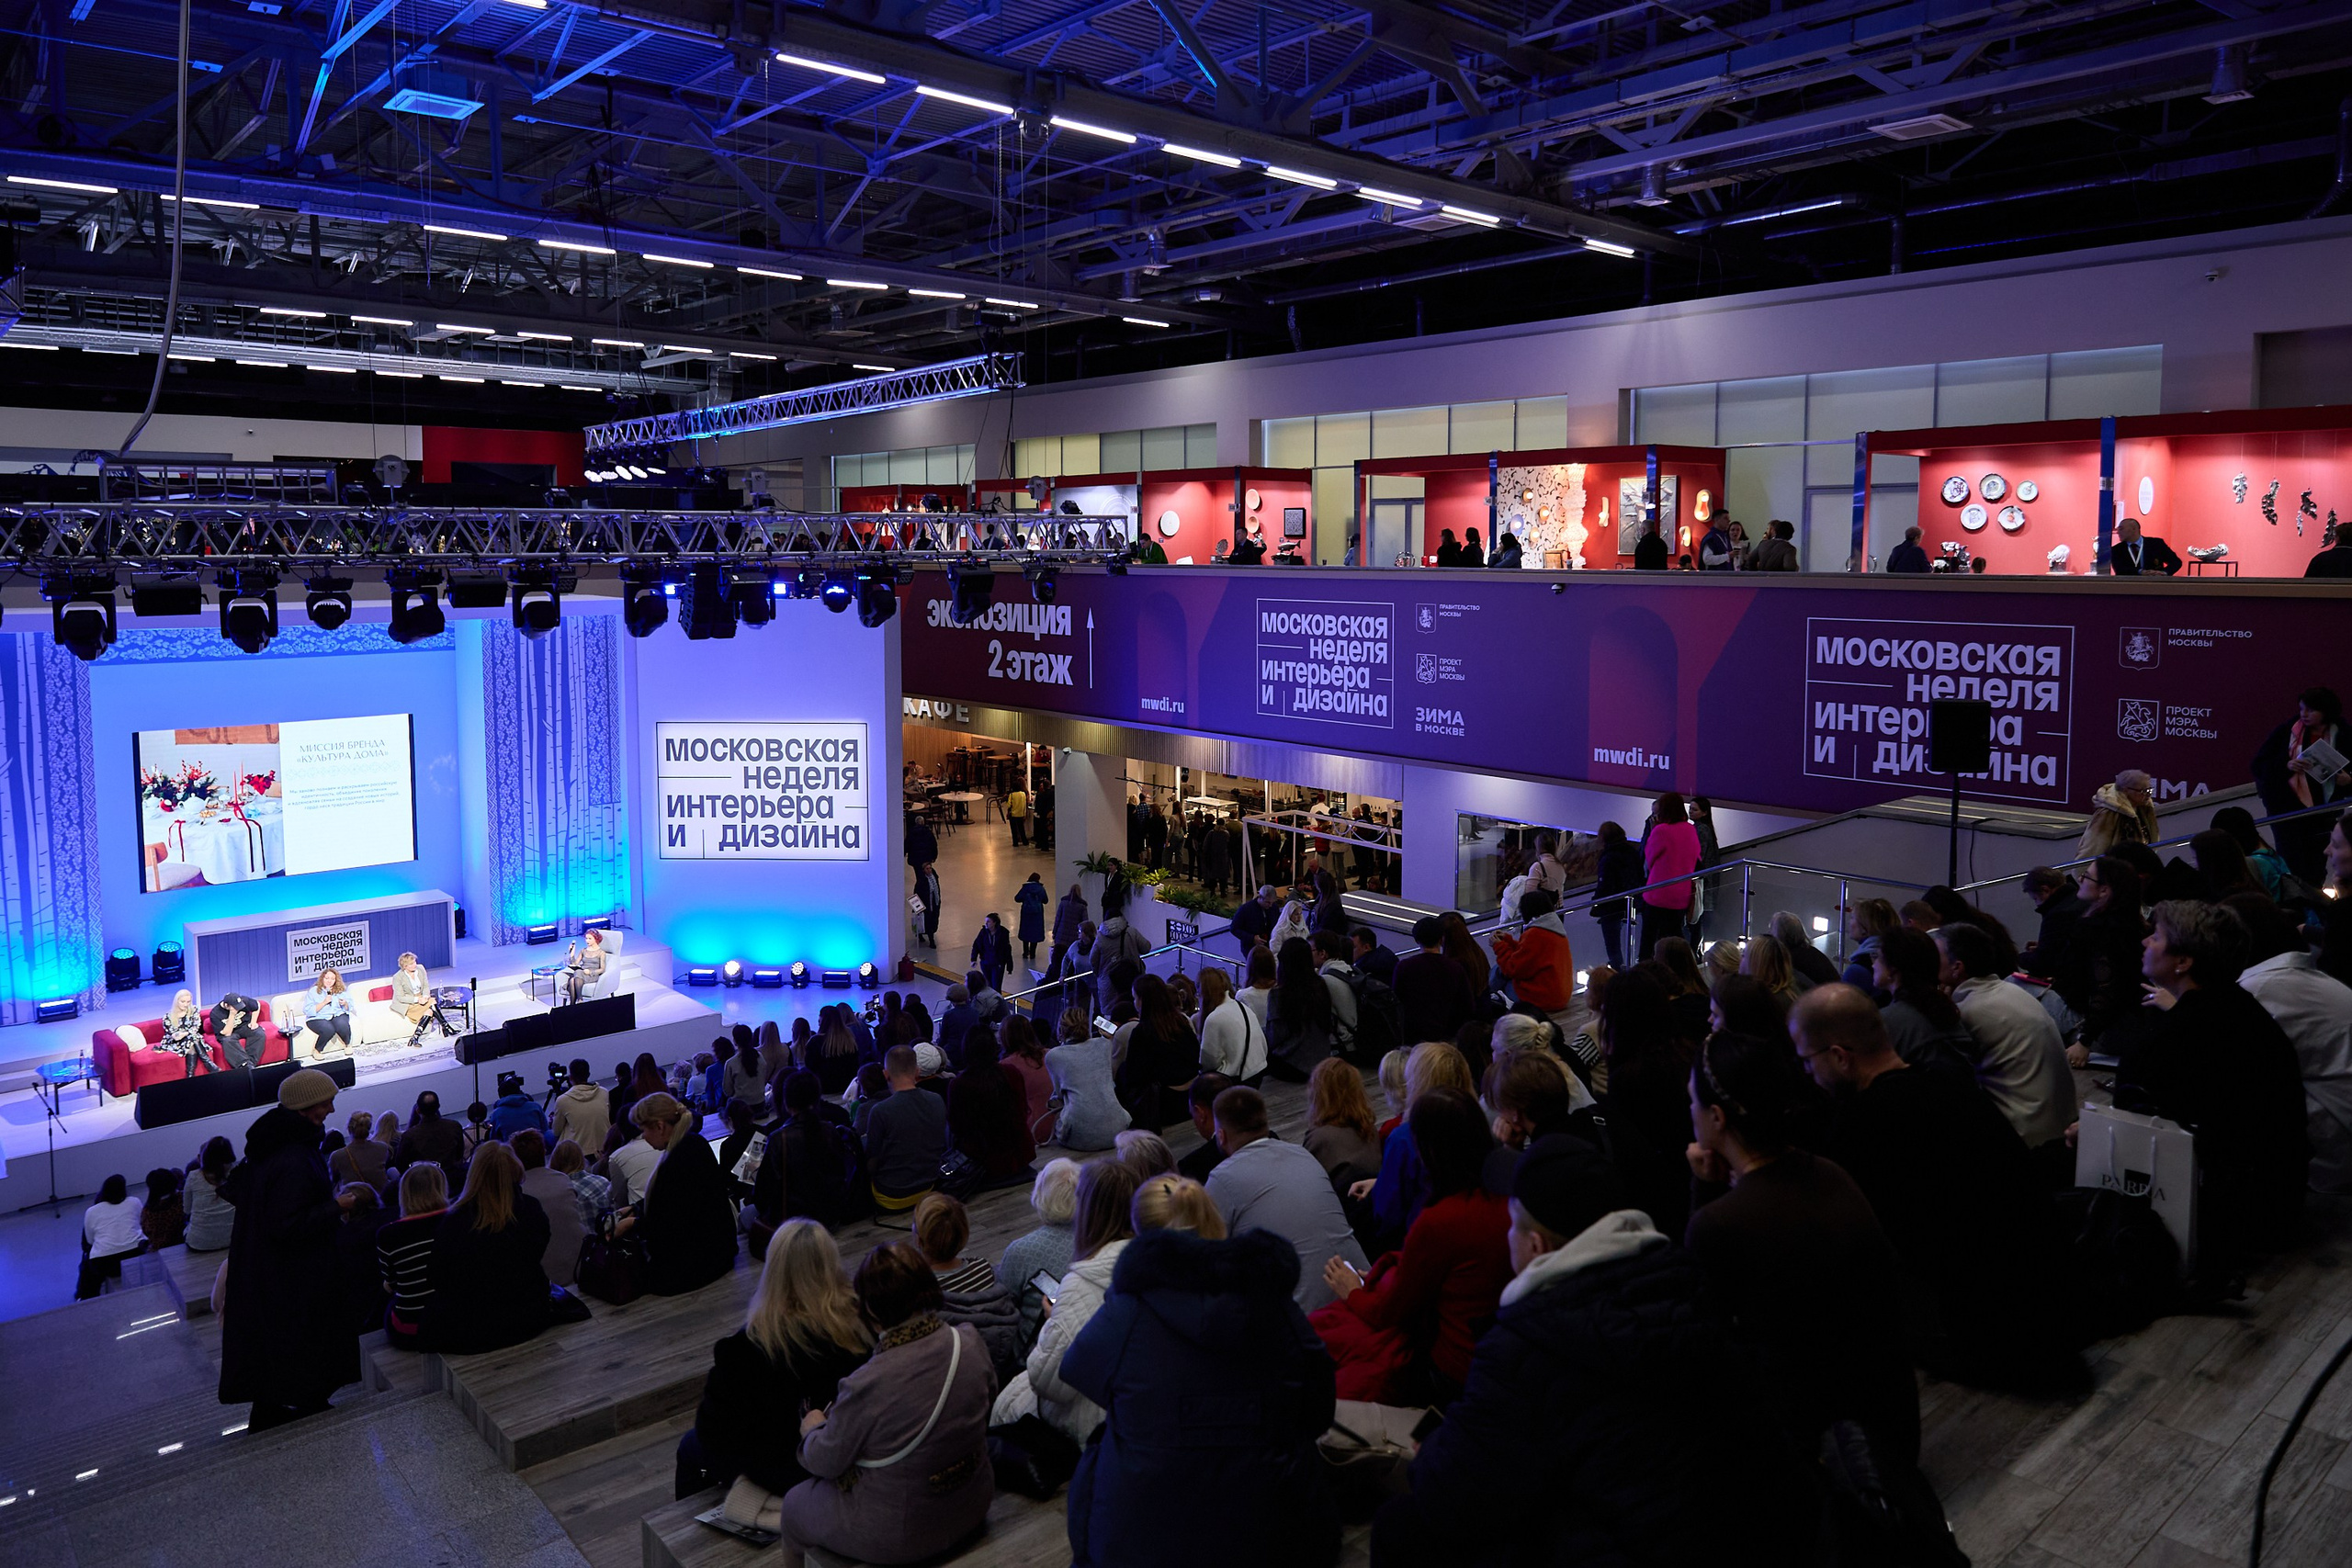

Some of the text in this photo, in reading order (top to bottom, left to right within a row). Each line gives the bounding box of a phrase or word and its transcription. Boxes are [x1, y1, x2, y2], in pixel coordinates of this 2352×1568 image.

[1261, 612, 1387, 639] московская
[2168, 628, 2253, 638] ПРАВИТЕЛЬСТВО
[1309, 637, 1387, 665] неделя
[2167, 638, 2212, 648] МОСКВЫ
[988, 639, 1074, 686] 2 этаж
[1439, 658, 1463, 667] ПРОЕКТ
[1815, 635, 2061, 677] московская
[1261, 660, 1370, 692] интерьера
[1439, 665, 1456, 673] МЭРА
[1439, 672, 1465, 681] МОСКВЫ
[1141, 696, 1184, 714] mwdi.ru
[1261, 684, 1387, 717] и дизайна
[1415, 706, 1464, 727] ЗИМА
[2165, 705, 2212, 718] ПРОЕКТ
[1415, 723, 1464, 737] В МОСКВЕ
[1814, 701, 2022, 747] интера
[2165, 716, 2199, 728] МЭРА
[2165, 727, 2217, 739] МОСКВЫ
[300, 739, 386, 752] МИССИЯ БРЕНДА
[665, 738, 859, 762] московская
[1814, 735, 1836, 764] и
[1593, 745, 1670, 771] mwdi.ru
[743, 765, 859, 794] неделя
[667, 795, 833, 824] интерьера
[668, 821, 860, 852] и дизайна
[294, 930, 362, 947] московская
[322, 938, 363, 952] неделя
[294, 948, 355, 965] интерьера
[294, 964, 303, 974] и
